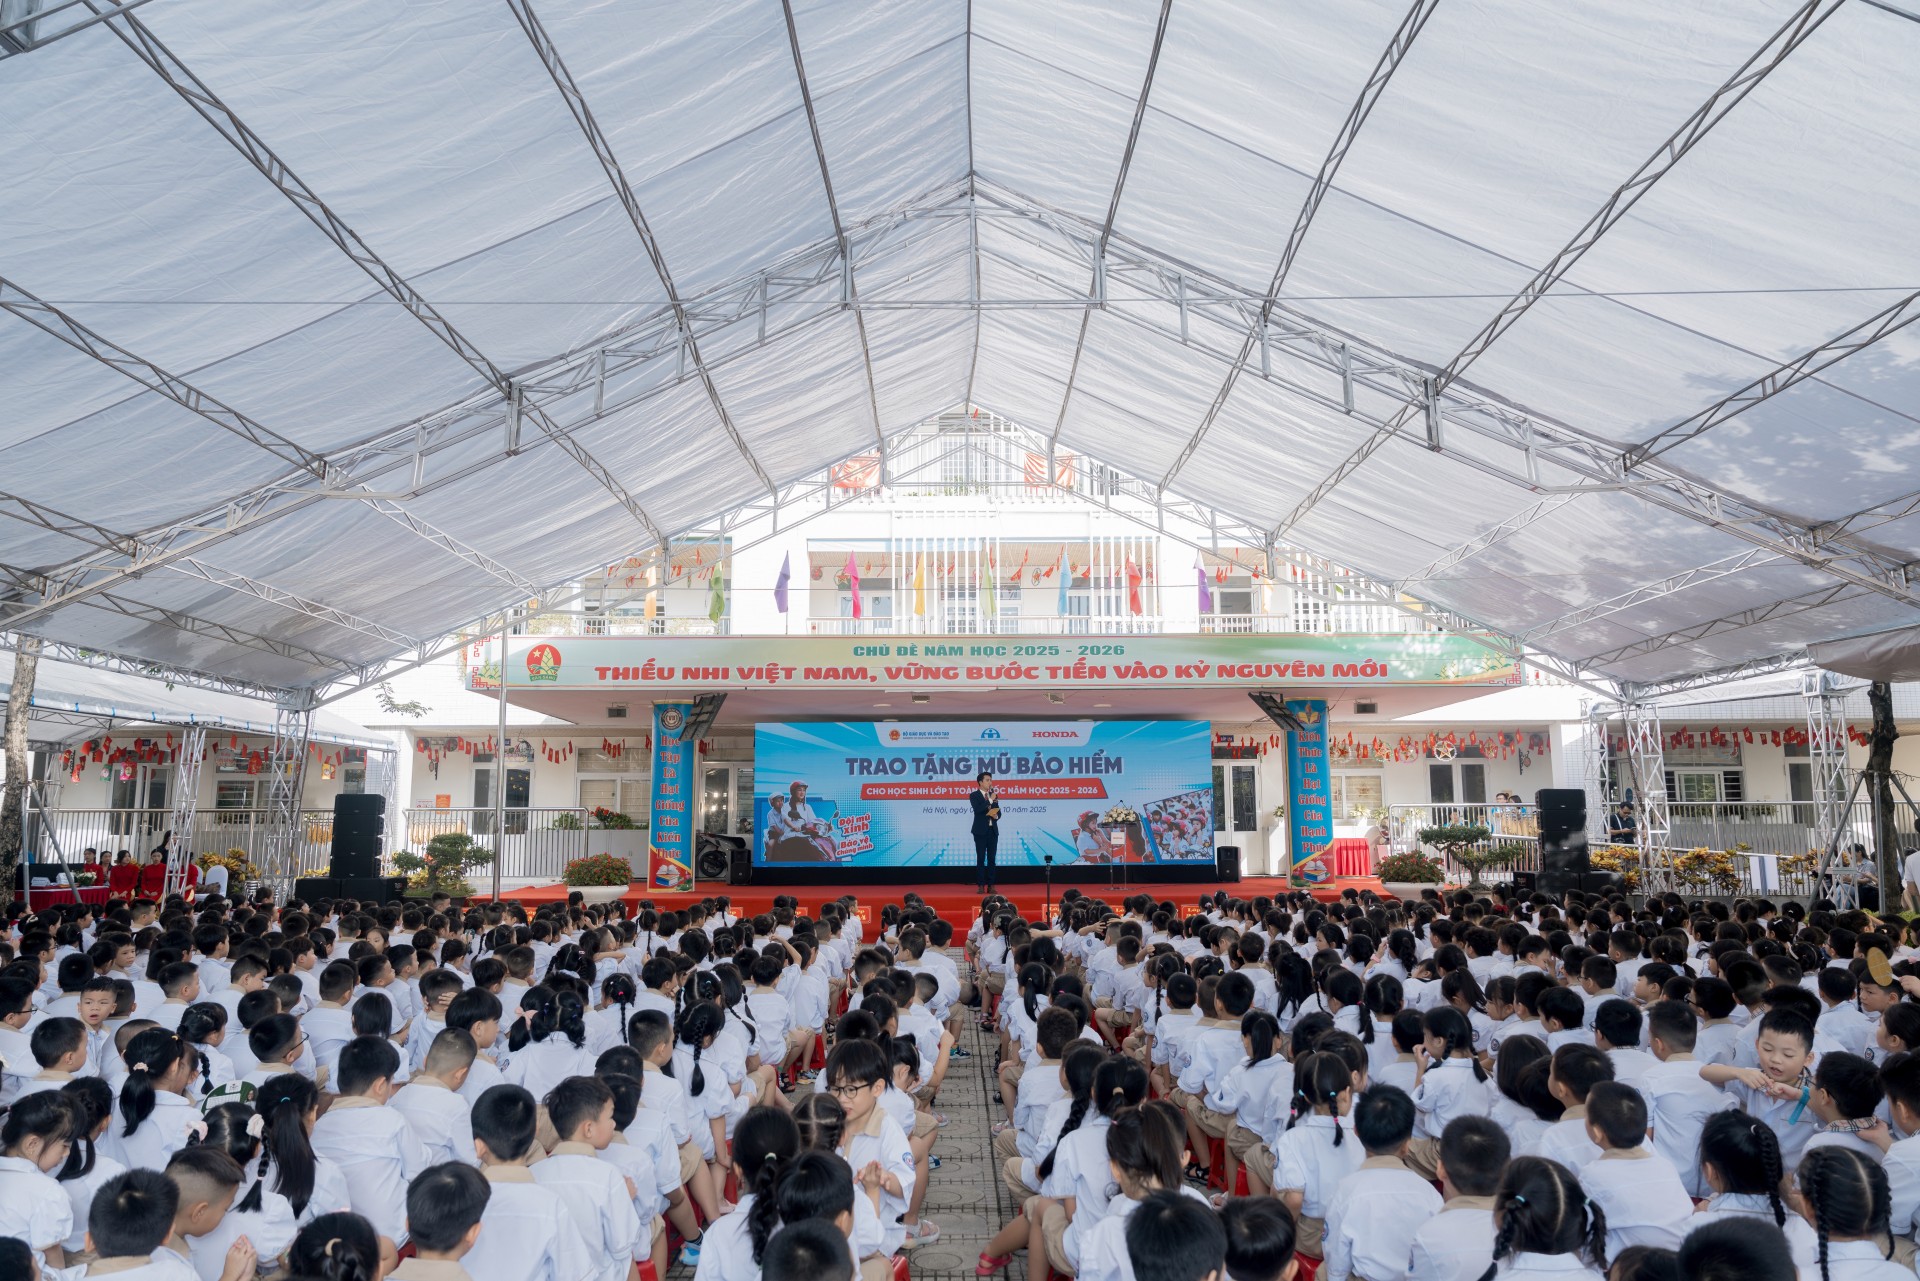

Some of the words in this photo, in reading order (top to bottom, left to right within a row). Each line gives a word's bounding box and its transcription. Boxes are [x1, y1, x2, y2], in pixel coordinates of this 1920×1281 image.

[853, 643, 890, 657] CHỦ
[896, 642, 918, 657] ĐỀ
[924, 644, 964, 657] NĂM
[970, 645, 1007, 658] HỌC
[1013, 645, 1060, 656] 2025
[1078, 645, 1125, 656] 2026
[594, 657, 675, 681] THIẾU
[681, 667, 730, 680] NHI
[736, 662, 797, 684] VIỆT
[803, 667, 878, 682] NAM,
[884, 662, 959, 680] VỮNG
[966, 660, 1040, 680] BƯỚC
[1045, 657, 1109, 680] TIẾN
[1112, 660, 1169, 679] VÀO
[1174, 659, 1211, 679] KỶ
[1216, 660, 1326, 678] NGUYÊN
[1332, 658, 1388, 678] MỚI
[660, 735, 681, 747] Học
[1298, 731, 1321, 743] Kiến
[660, 751, 681, 763] Tập
[1297, 746, 1322, 758] Thức
[845, 758, 907, 775] TRAO
[912, 753, 972, 780] TẶNG
[977, 752, 1011, 774] MŨ
[1017, 751, 1064, 774] BẢO
[1069, 749, 1122, 774] HIỂM
[1305, 762, 1317, 774] Là
[663, 767, 676, 778] Là
[660, 783, 679, 796] Hạt
[1303, 778, 1321, 790] Hạt
[866, 787, 886, 795] CHO
[887, 787, 907, 797] HỌC
[908, 787, 928, 795] SINH
[930, 785, 947, 794] LỚP
[1008, 785, 1027, 794] NĂM
[1029, 787, 1048, 796] HỌC
[655, 798, 685, 812] Giống
[1298, 793, 1326, 806] Giống
[922, 806, 933, 814] Hà
[950, 806, 968, 815] ngày
[1303, 809, 1323, 821] Của
[658, 815, 679, 826] Của
[856, 813, 870, 822] mũ
[844, 822, 869, 834] xinh
[1301, 825, 1327, 838] Hạnh
[656, 830, 681, 843] Kiến
[840, 839, 858, 848] Bảo
[1302, 841, 1327, 853] Phúc
[655, 847, 682, 859] Thức
